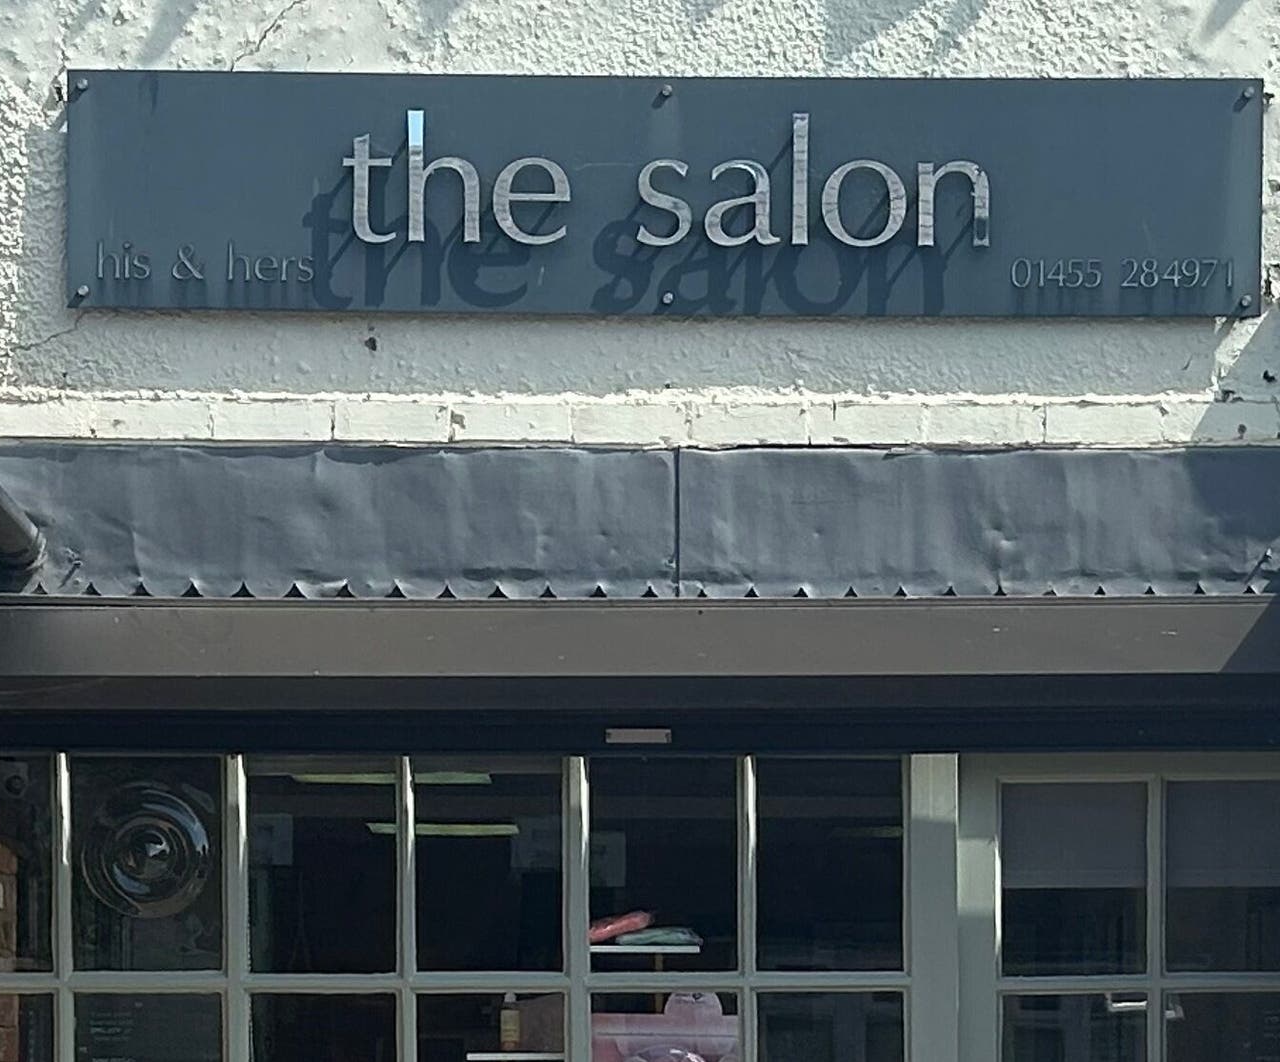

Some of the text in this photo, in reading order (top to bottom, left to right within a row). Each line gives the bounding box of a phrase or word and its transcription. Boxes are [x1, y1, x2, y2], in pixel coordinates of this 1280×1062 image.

[342, 110, 990, 248] the salon
[96, 241, 316, 283] his & hers
[1010, 257, 1235, 289] 01455 284971
